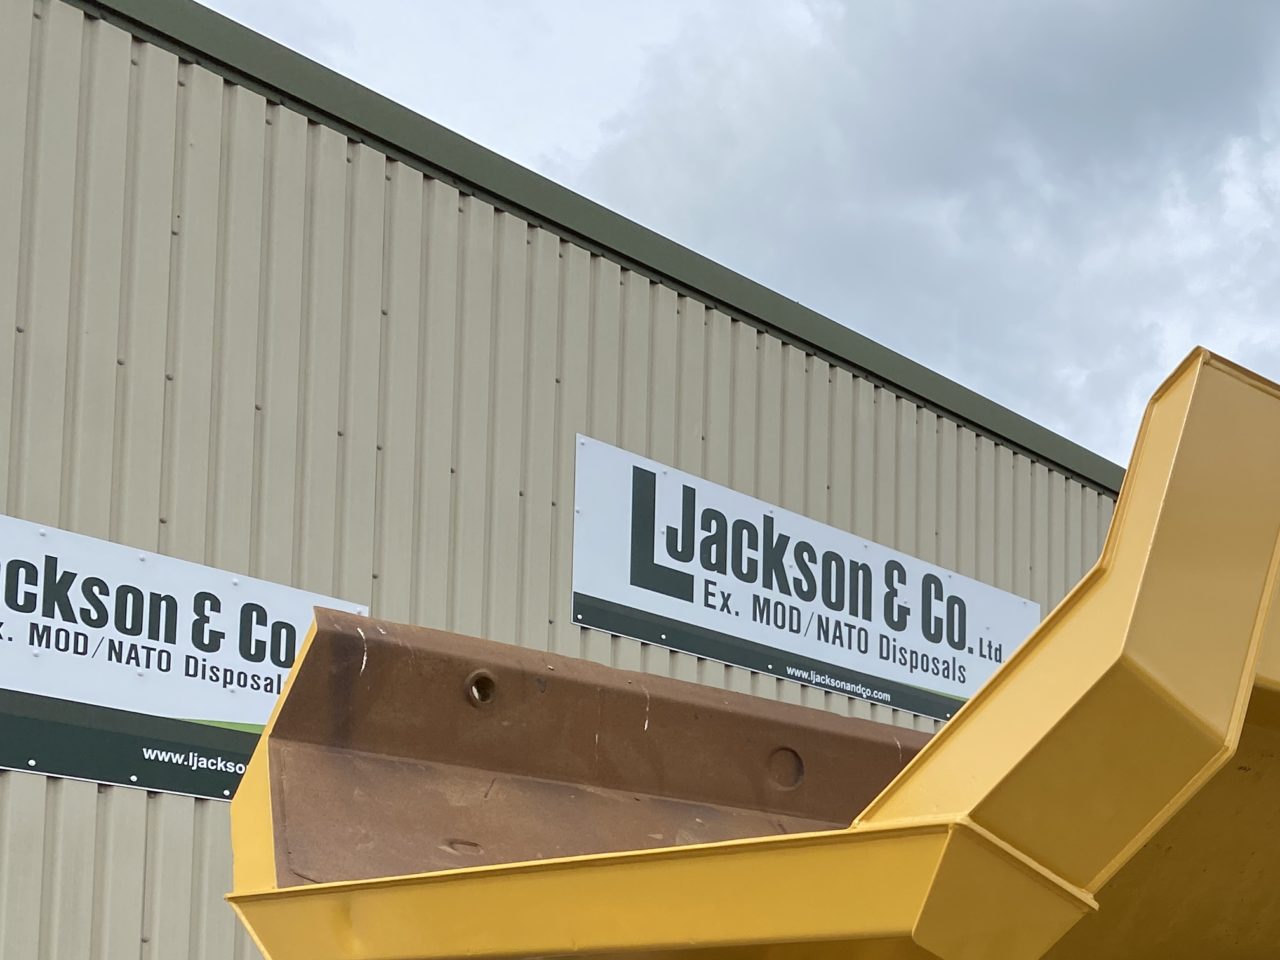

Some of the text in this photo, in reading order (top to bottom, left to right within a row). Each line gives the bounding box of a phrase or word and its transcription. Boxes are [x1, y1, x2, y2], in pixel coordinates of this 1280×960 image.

[0, 554, 178, 645] ckson
[191, 591, 225, 653] &
[703, 578, 740, 617] Ex.
[879, 633, 967, 684] Disposals
[883, 559, 911, 632] &
[921, 573, 974, 655] Co.
[143, 747, 248, 774] www.ljackso
